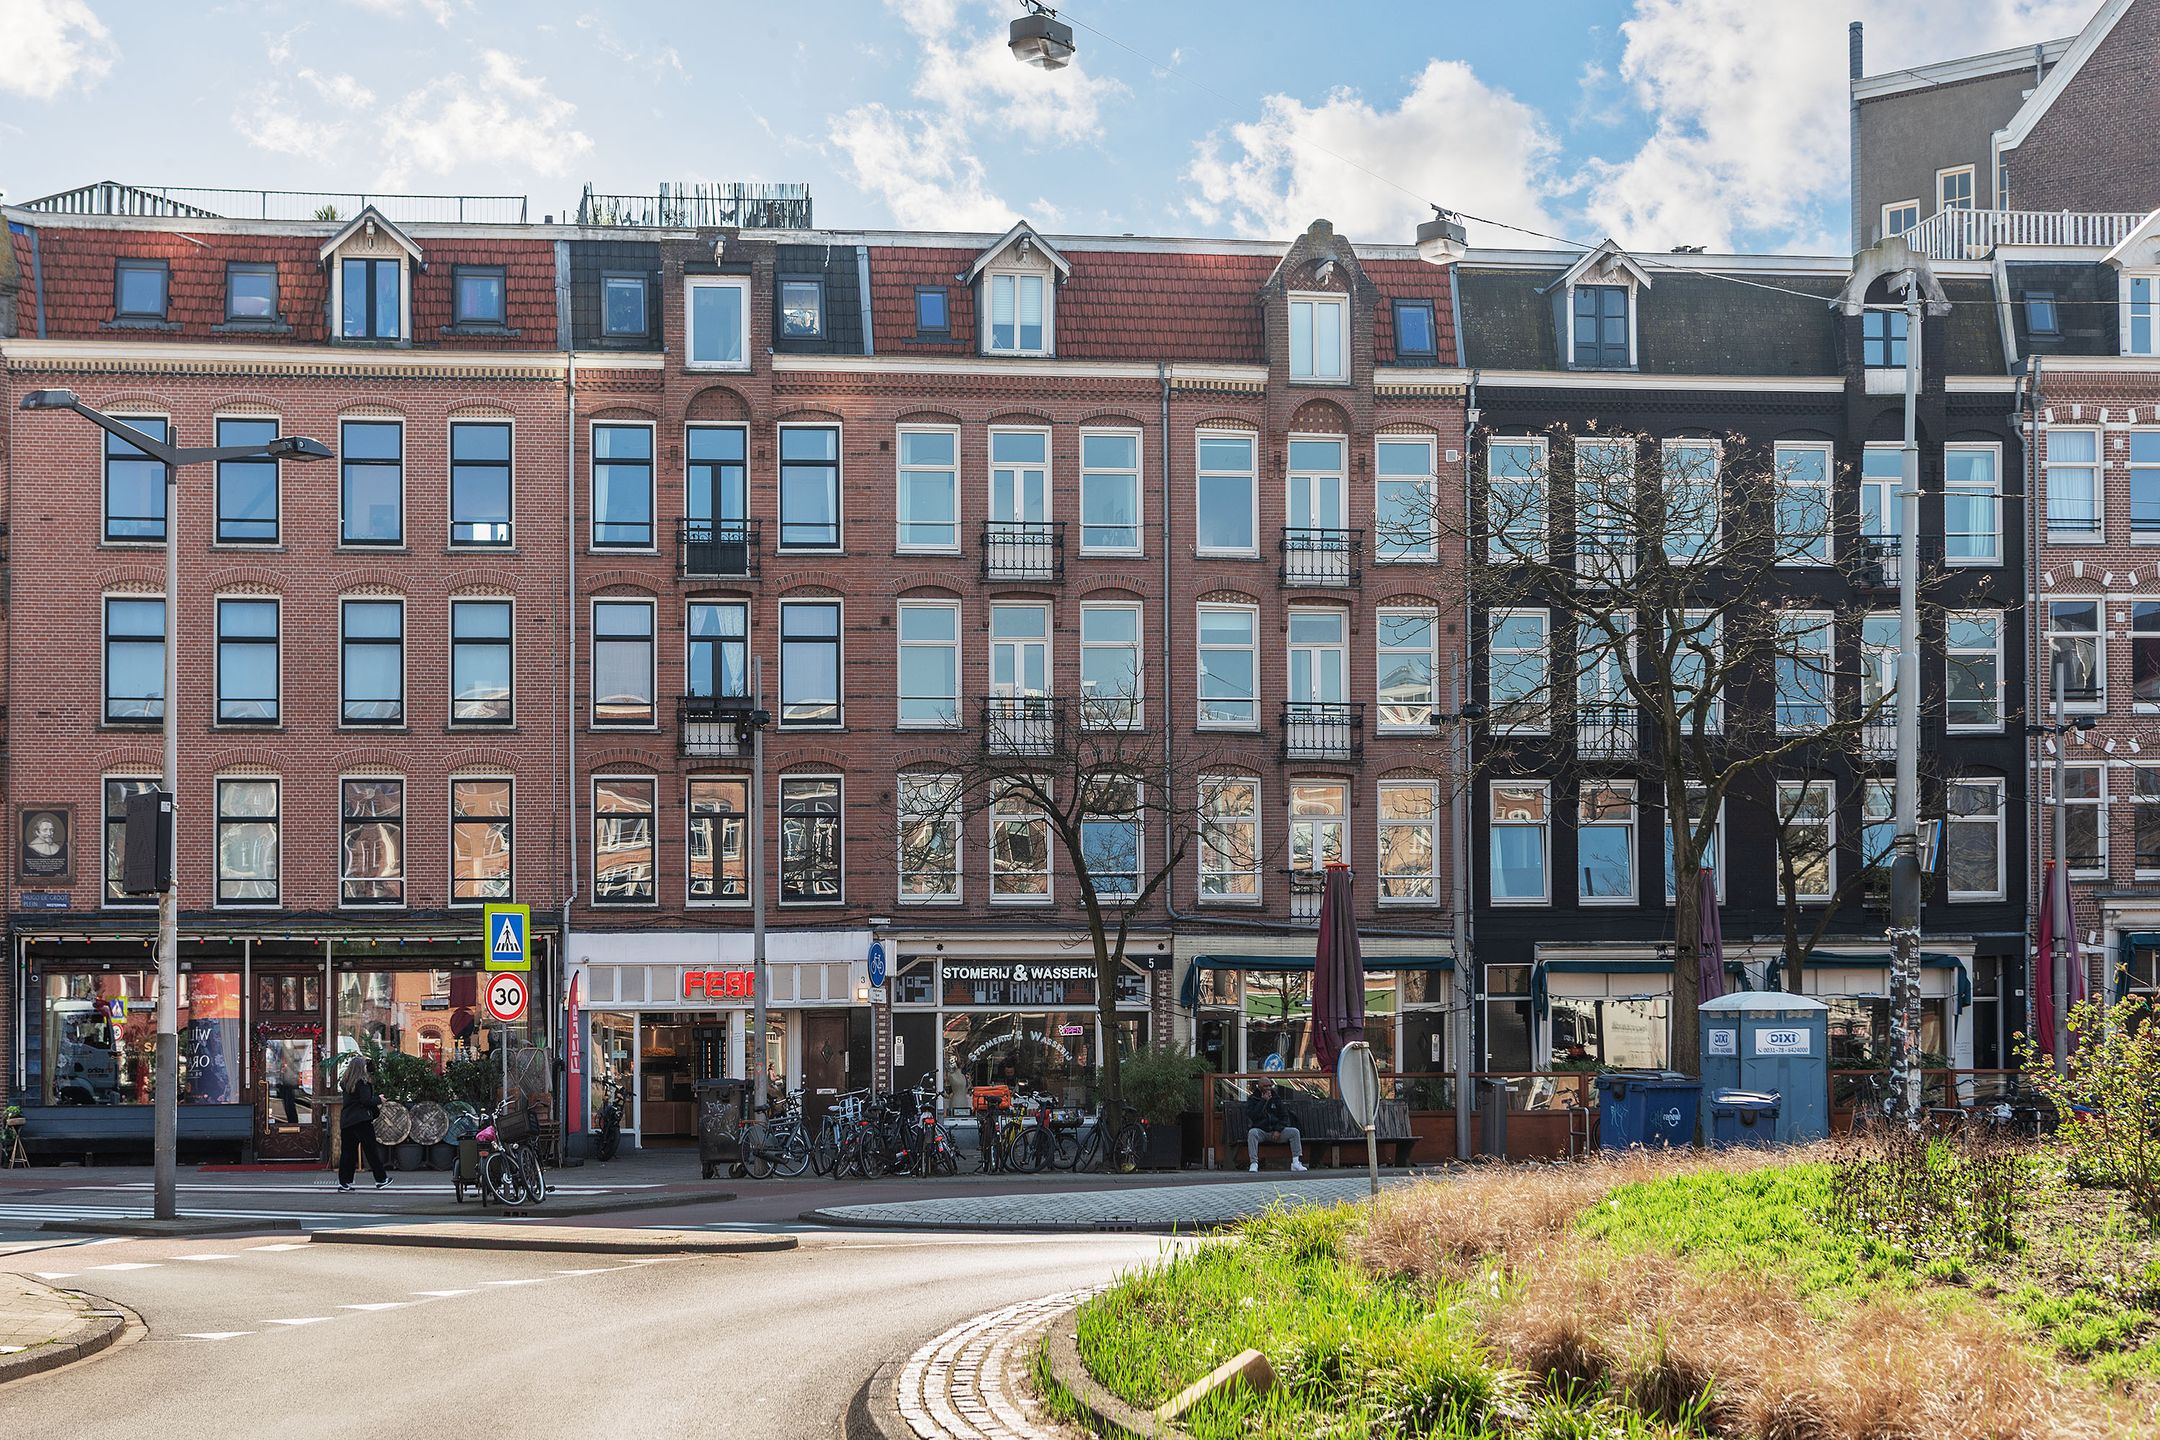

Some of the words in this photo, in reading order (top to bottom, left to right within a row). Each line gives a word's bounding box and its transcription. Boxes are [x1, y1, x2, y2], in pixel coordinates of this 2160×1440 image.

[1149, 958, 1154, 968] 5
[943, 967, 1010, 979] STOMERIJ
[1013, 964, 1028, 981] &
[1031, 967, 1098, 979] WASSERIJ
[861, 976, 866, 984] 3
[494, 988, 521, 1006] 30
[896, 1036, 902, 1044] 5
[967, 1033, 1012, 1062] STOMERIJ
[1030, 1030, 1073, 1061] WASSERIJ
